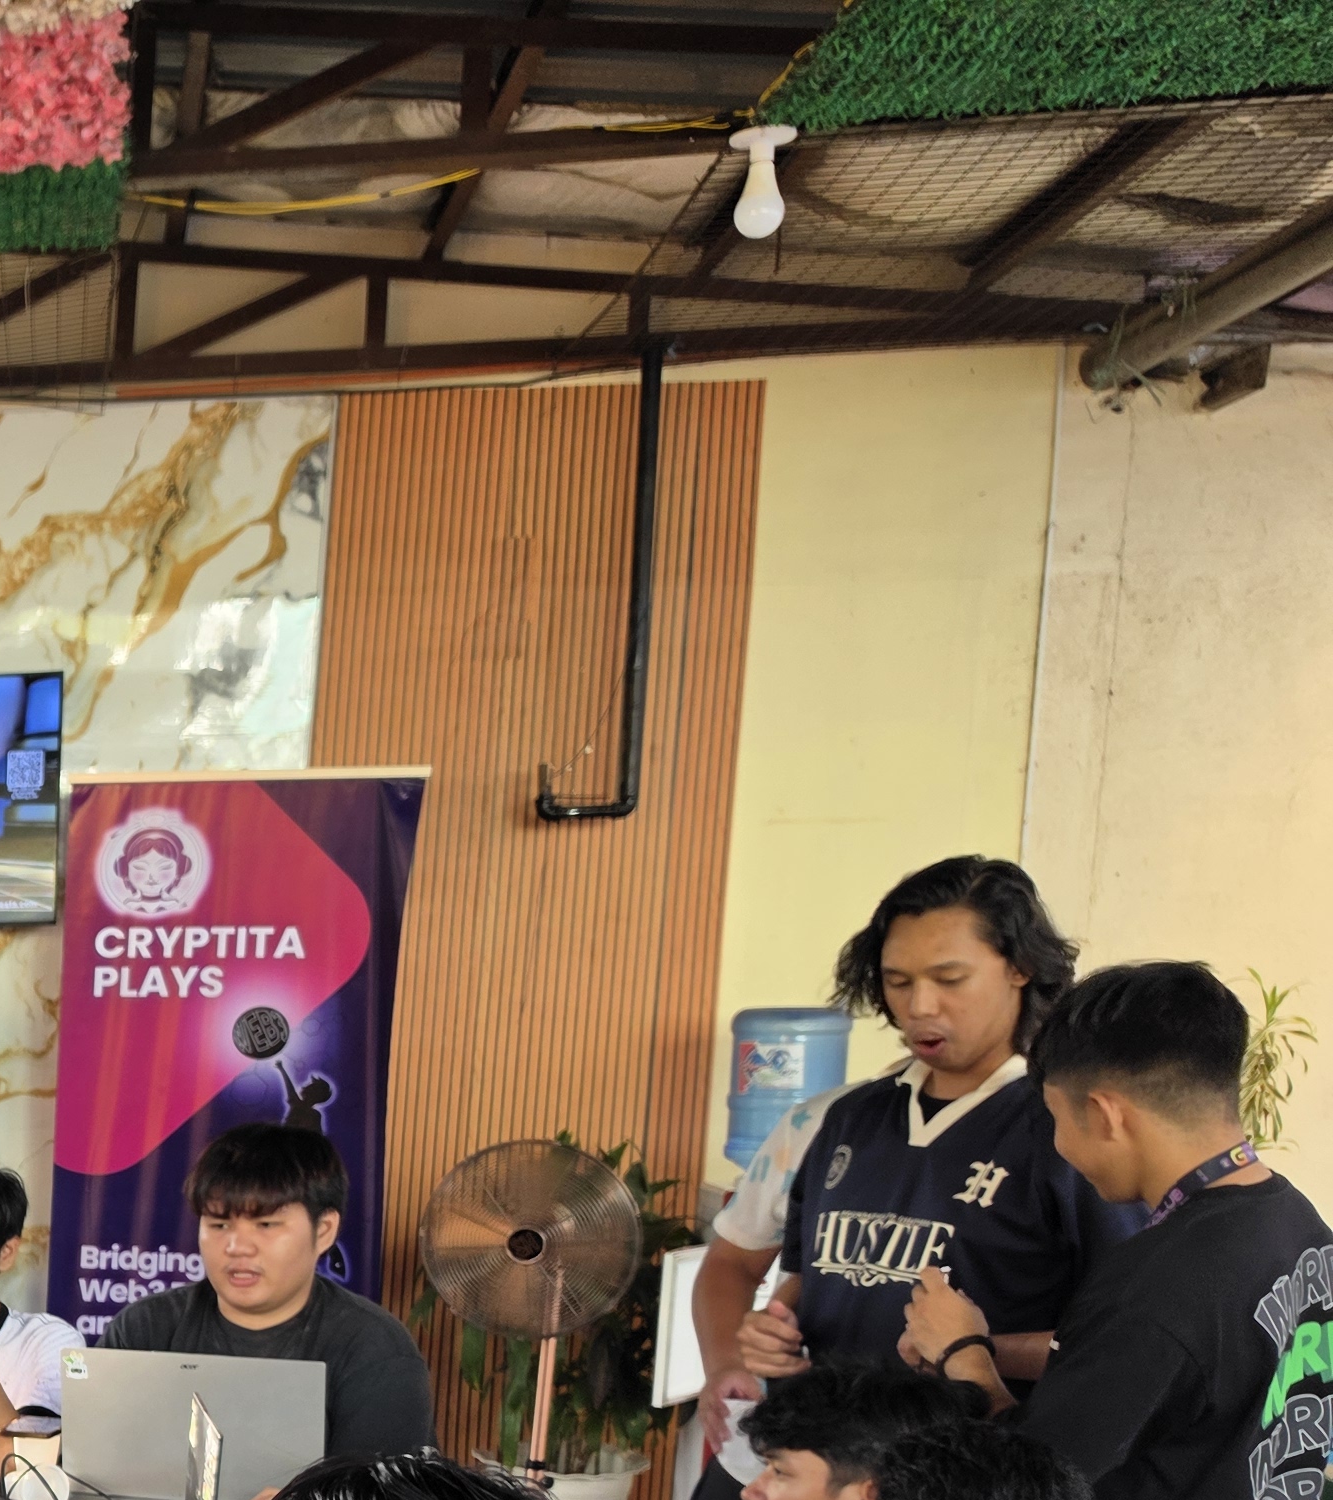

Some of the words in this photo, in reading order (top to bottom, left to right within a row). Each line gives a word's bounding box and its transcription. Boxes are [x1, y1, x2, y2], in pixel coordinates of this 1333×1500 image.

[94, 925, 306, 959] CRYPTITA
[93, 965, 224, 999] PLAYS
[80, 1243, 207, 1282] Bridging
[76, 1315, 114, 1335] an
